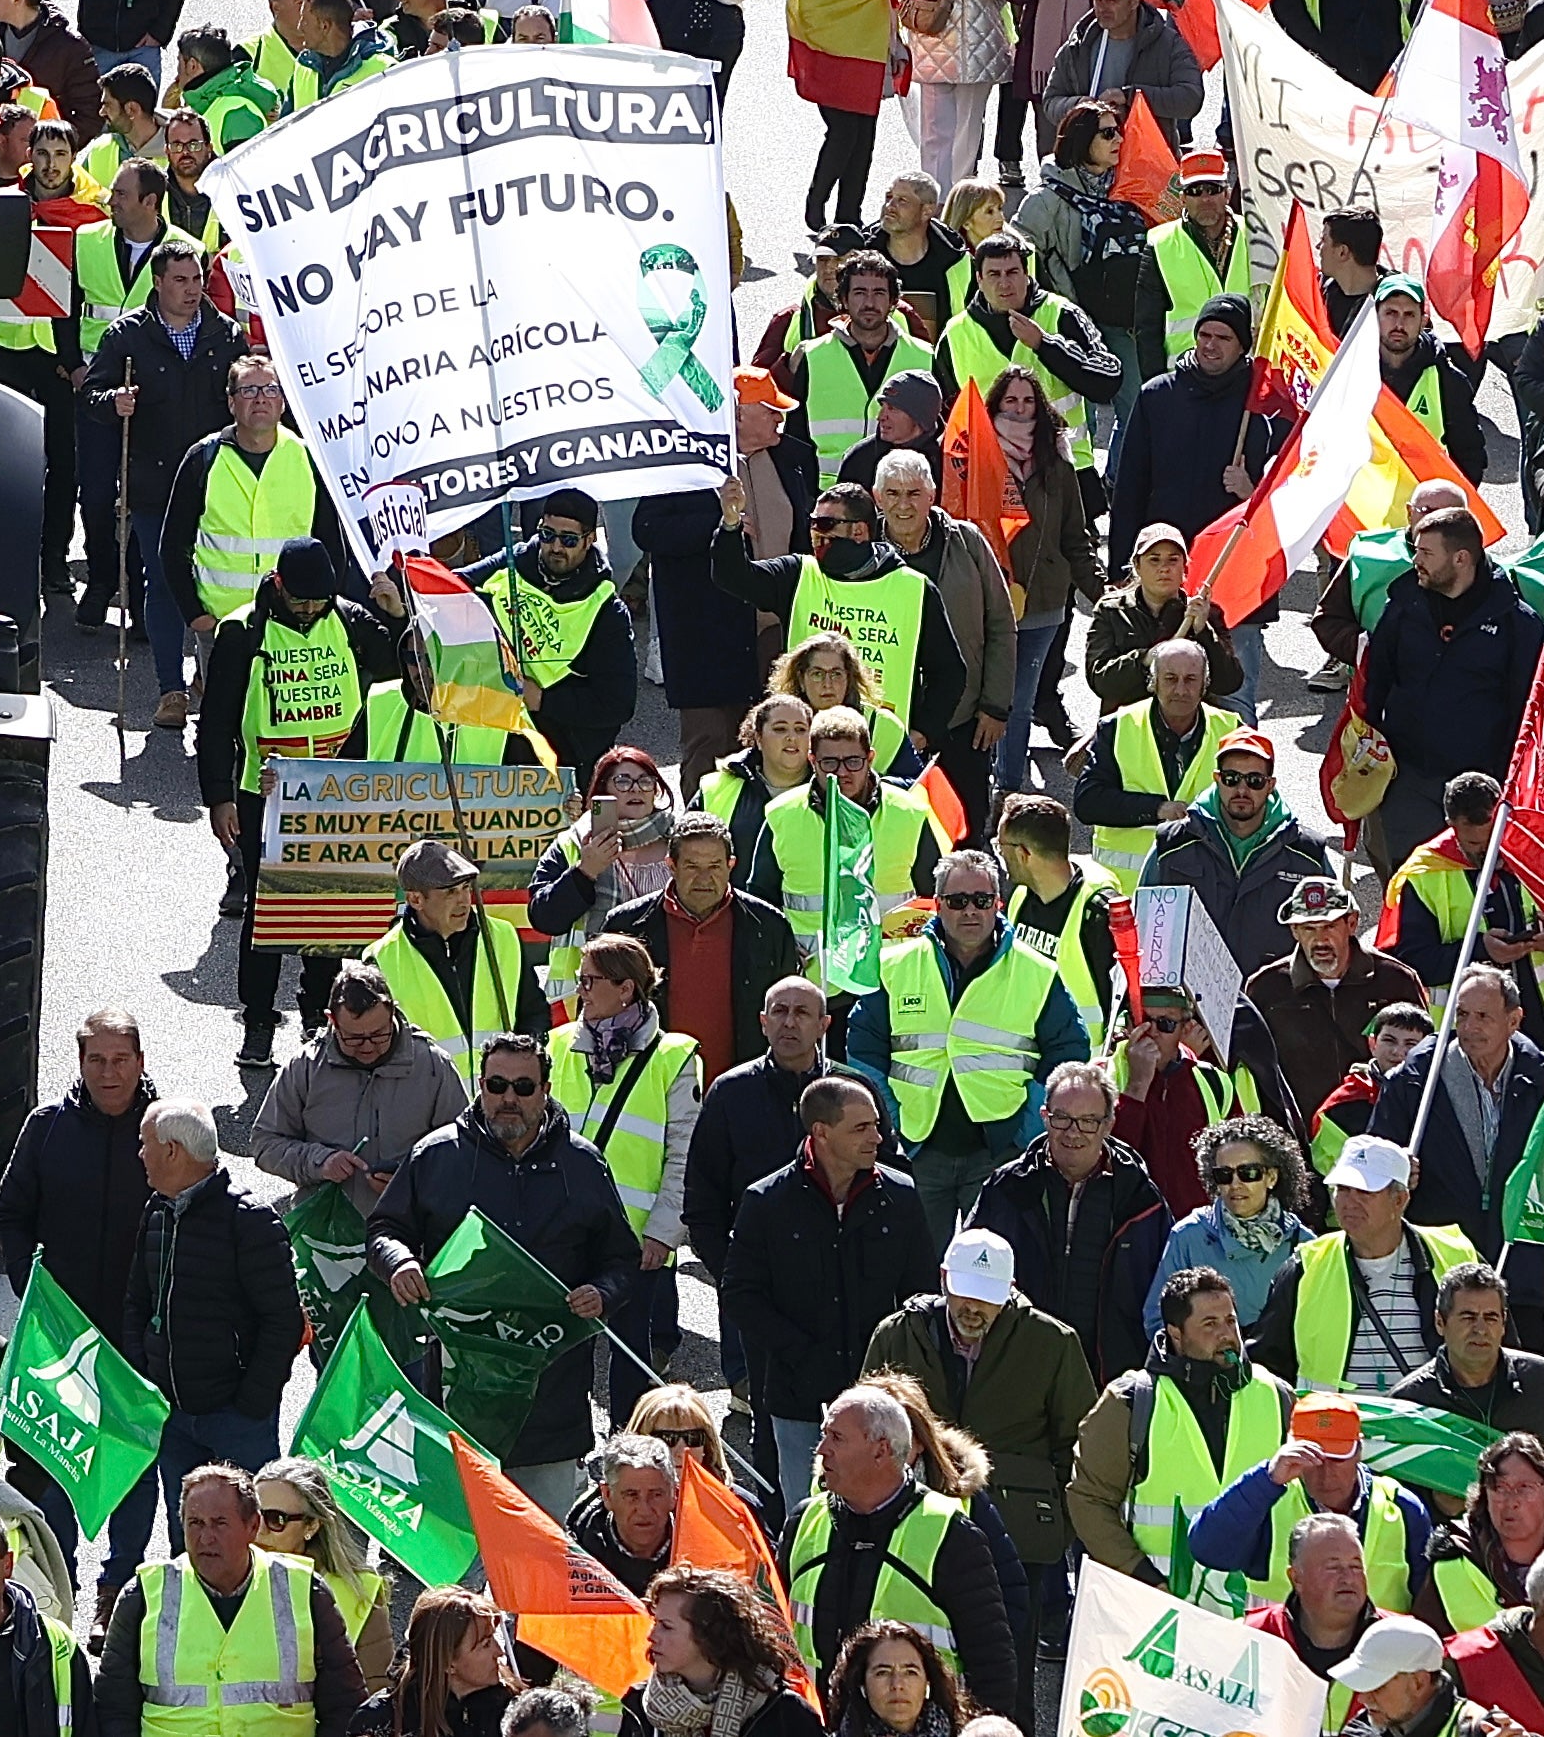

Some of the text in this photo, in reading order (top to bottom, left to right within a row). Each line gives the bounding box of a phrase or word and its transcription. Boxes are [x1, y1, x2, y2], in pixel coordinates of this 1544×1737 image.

[236, 85, 712, 234] SIN AGRICULTURA,
[266, 262, 334, 317] NO
[448, 172, 674, 235] FUTURO.
[296, 360, 326, 389] EL
[413, 284, 460, 319] DE
[469, 278, 499, 308] LA
[318, 350, 458, 445] MAQNARIA
[340, 376, 614, 500] EN A NUESTROS
[858, 626, 899, 647] SERÁ
[268, 657, 350, 685] UINA SERÁ
[273, 703, 343, 724] HAMBRE
[281, 767, 565, 802] LA AGRICULTURA
[279, 806, 563, 835] ES MUY FÁCIL CUANDO
[282, 842, 310, 864] SE
[318, 842, 360, 864] ARA
[1149, 887, 1177, 904] NO
[9, 1376, 96, 1477] ASAJA
[32, 1428, 50, 1447] La
[49, 1444, 82, 1483] Mancha
[322, 1448, 424, 1533] ASAJA
